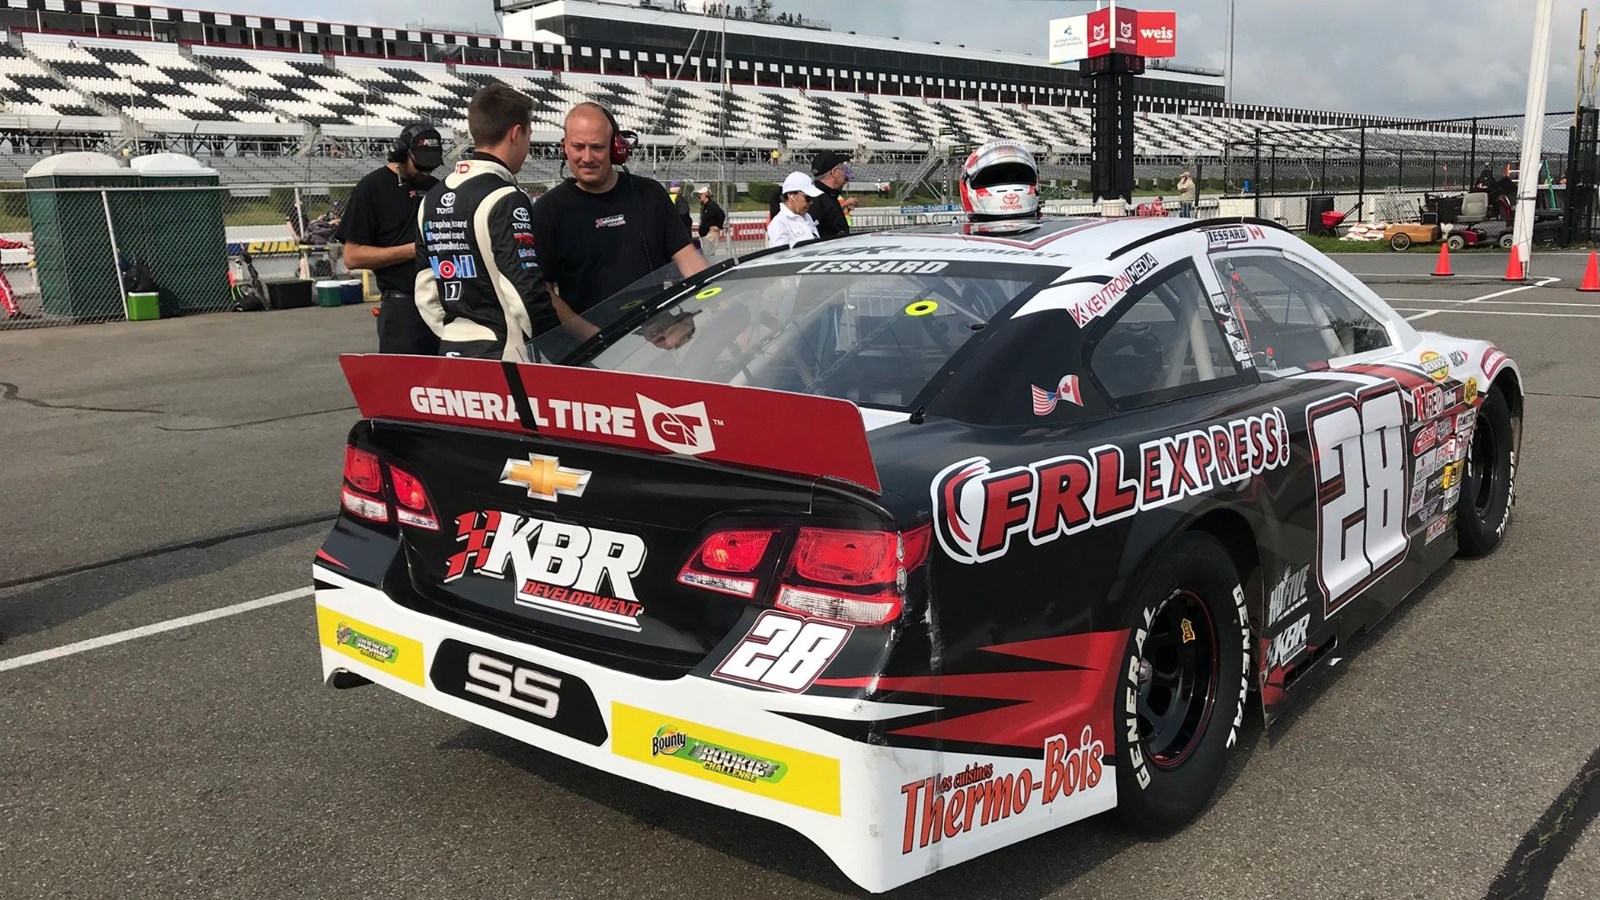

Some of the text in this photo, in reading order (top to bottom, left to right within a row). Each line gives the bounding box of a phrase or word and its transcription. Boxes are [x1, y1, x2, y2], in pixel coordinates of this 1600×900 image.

[1140, 26, 1174, 39] weis
[796, 260, 951, 274] LESSARD
[1086, 254, 1158, 315] KEVTRON MEDIA
[409, 386, 636, 438] GENERAL TIRE
[976, 408, 1289, 552] FRL EXPRESS!
[1310, 385, 1410, 610] 28
[474, 511, 648, 602] KBR
[519, 579, 642, 617] DEVELOPMENT
[715, 612, 851, 692] 28
[1225, 583, 1251, 749] GENERAL
[464, 651, 562, 719] SS
[1125, 606, 1157, 791] GENERAL
[652, 732, 687, 758] Bounty
[699, 743, 770, 778] ROOKIE
[703, 761, 759, 783] CHALLENGE
[953, 761, 994, 788] cuisines
[900, 726, 1104, 856] Thermo-Bois
